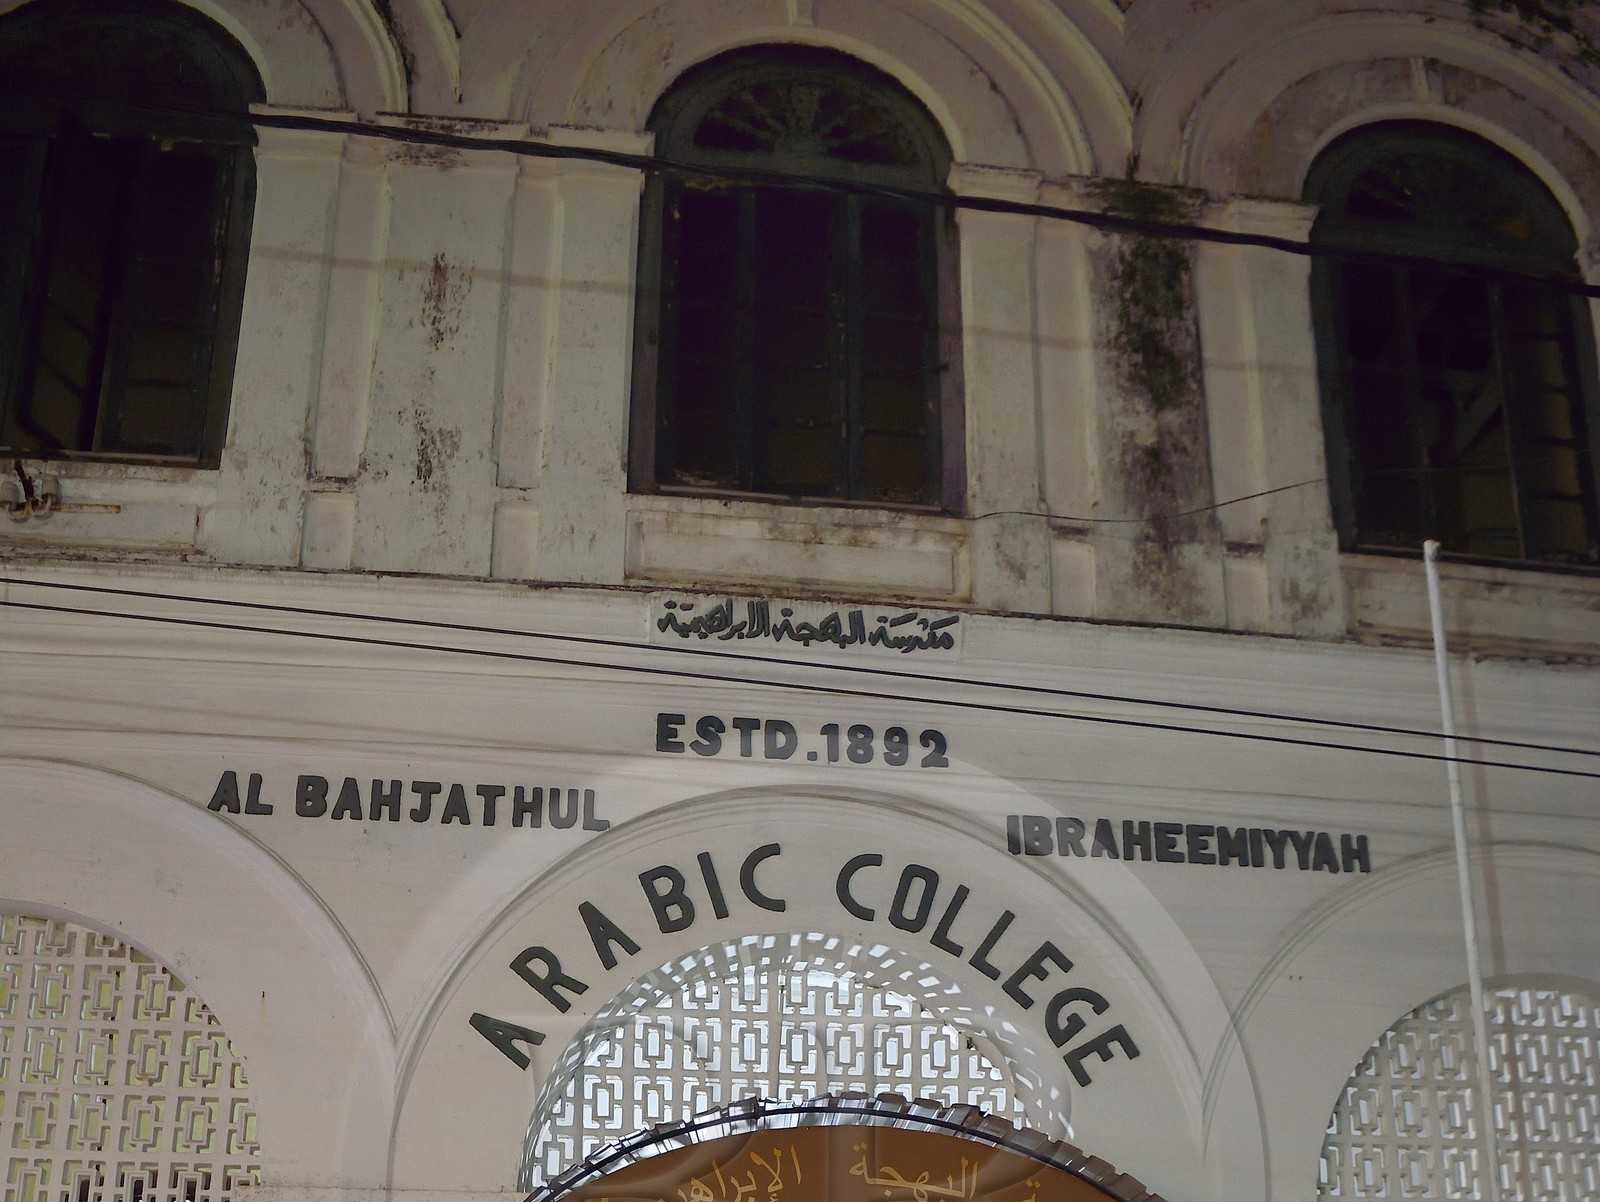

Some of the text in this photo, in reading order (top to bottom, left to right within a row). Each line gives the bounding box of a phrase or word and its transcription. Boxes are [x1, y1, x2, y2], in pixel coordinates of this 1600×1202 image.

[207, 770, 610, 831] AL BAHJATHUL
[1006, 814, 1371, 873] IBRAHEEMIYYAH
[468, 842, 1141, 1087] ARABIC COLLEGE
